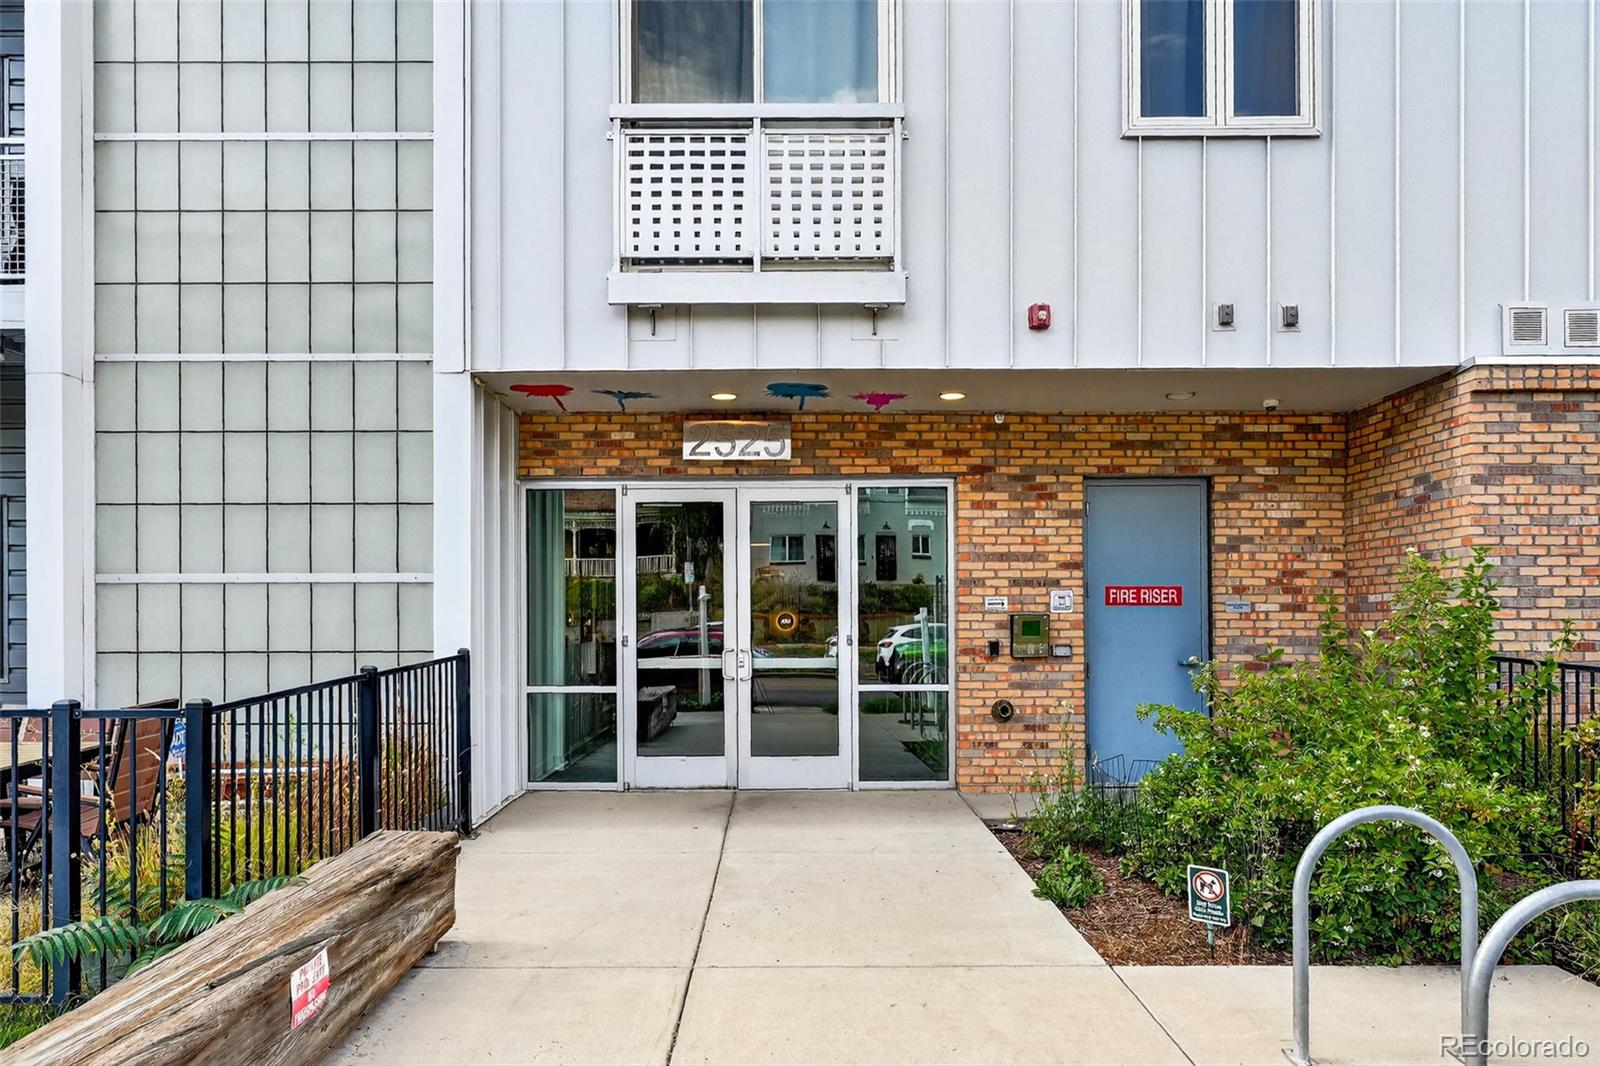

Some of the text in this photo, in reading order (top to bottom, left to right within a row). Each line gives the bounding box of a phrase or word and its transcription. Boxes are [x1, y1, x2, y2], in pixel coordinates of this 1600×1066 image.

[689, 423, 786, 457] 2525
[1109, 589, 1178, 604] FIRE RISER
